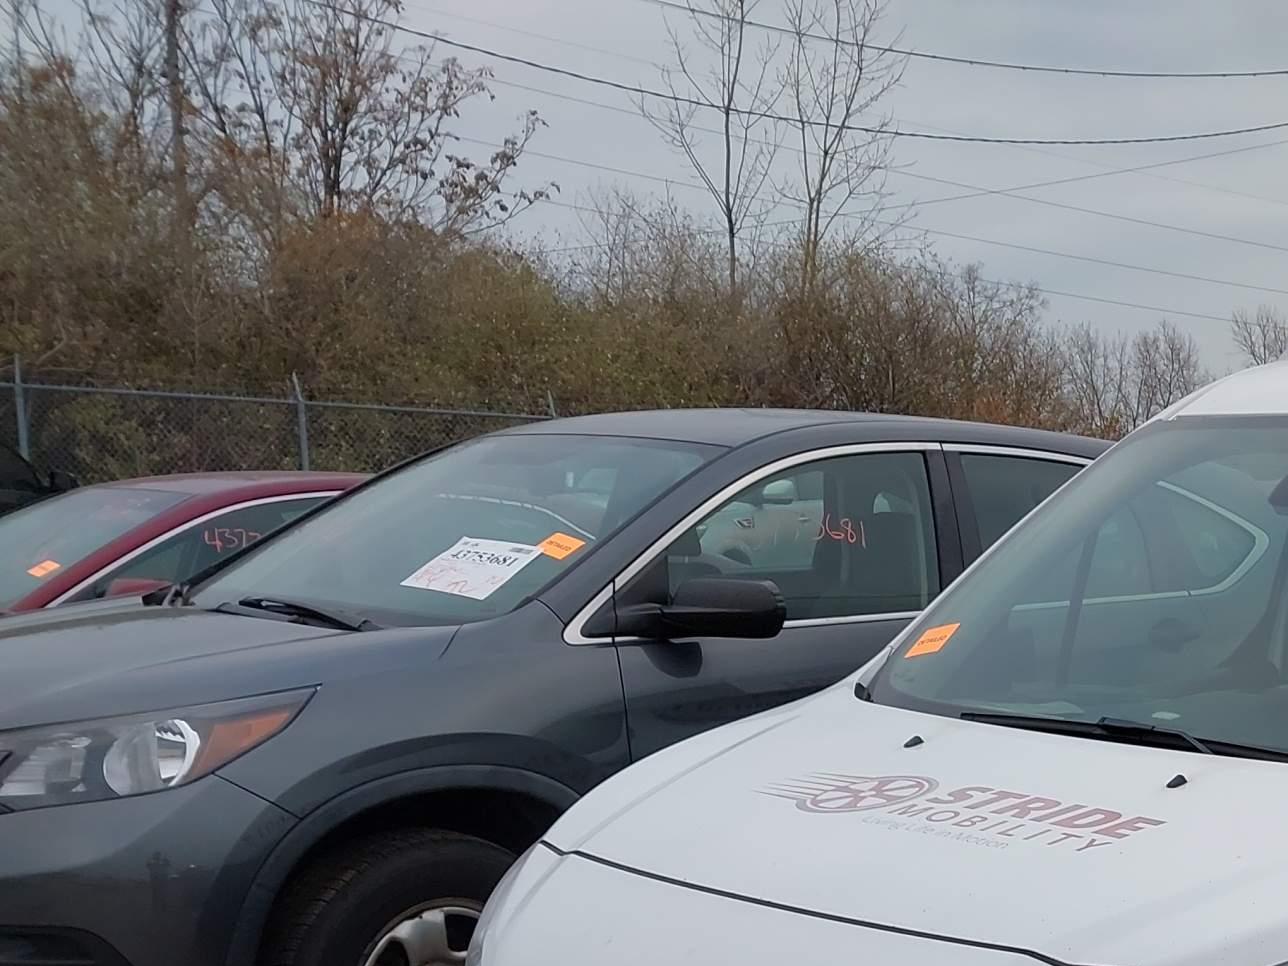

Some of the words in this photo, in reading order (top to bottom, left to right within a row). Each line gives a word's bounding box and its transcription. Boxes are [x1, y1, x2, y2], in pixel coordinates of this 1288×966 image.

[451, 549, 519, 567] 43753681
[887, 804, 1112, 852] MOBILITY
[927, 786, 1168, 839] STRIDE
